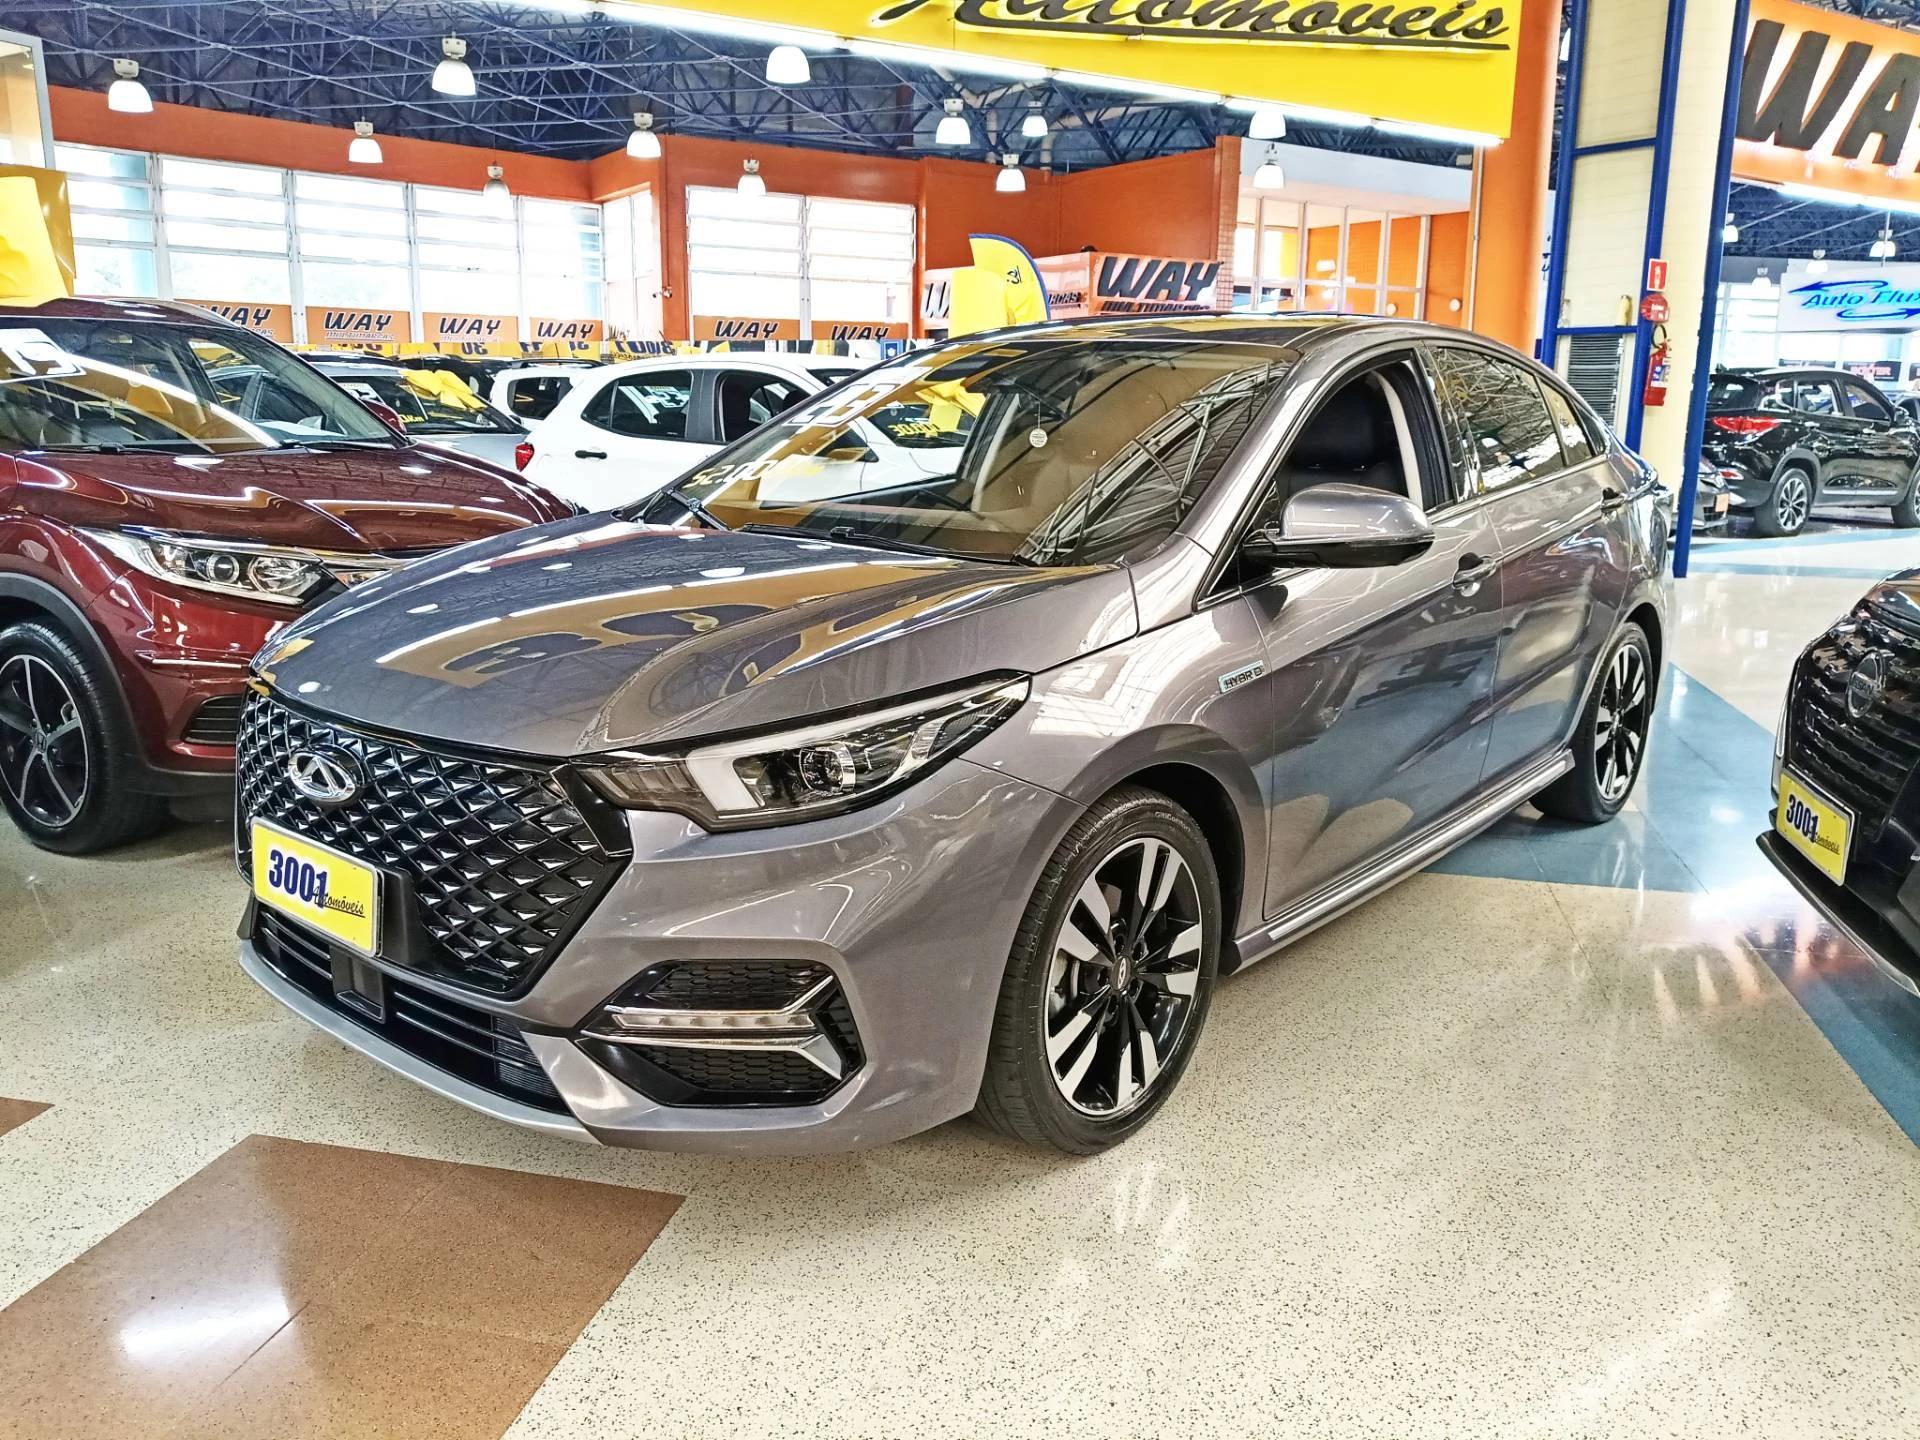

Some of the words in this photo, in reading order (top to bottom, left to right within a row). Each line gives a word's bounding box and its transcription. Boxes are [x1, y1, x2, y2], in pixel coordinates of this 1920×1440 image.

[1735, 18, 1920, 173] WA
[1099, 256, 1221, 301] WAY
[1801, 292, 1865, 307] Auto
[324, 311, 393, 332] WAY
[439, 317, 502, 335] WAY
[537, 321, 594, 339] WAY
[714, 320, 779, 338] WAY
[830, 325, 889, 340] WAY
[1786, 794, 1819, 843] 3001
[268, 849, 328, 909] 3001
